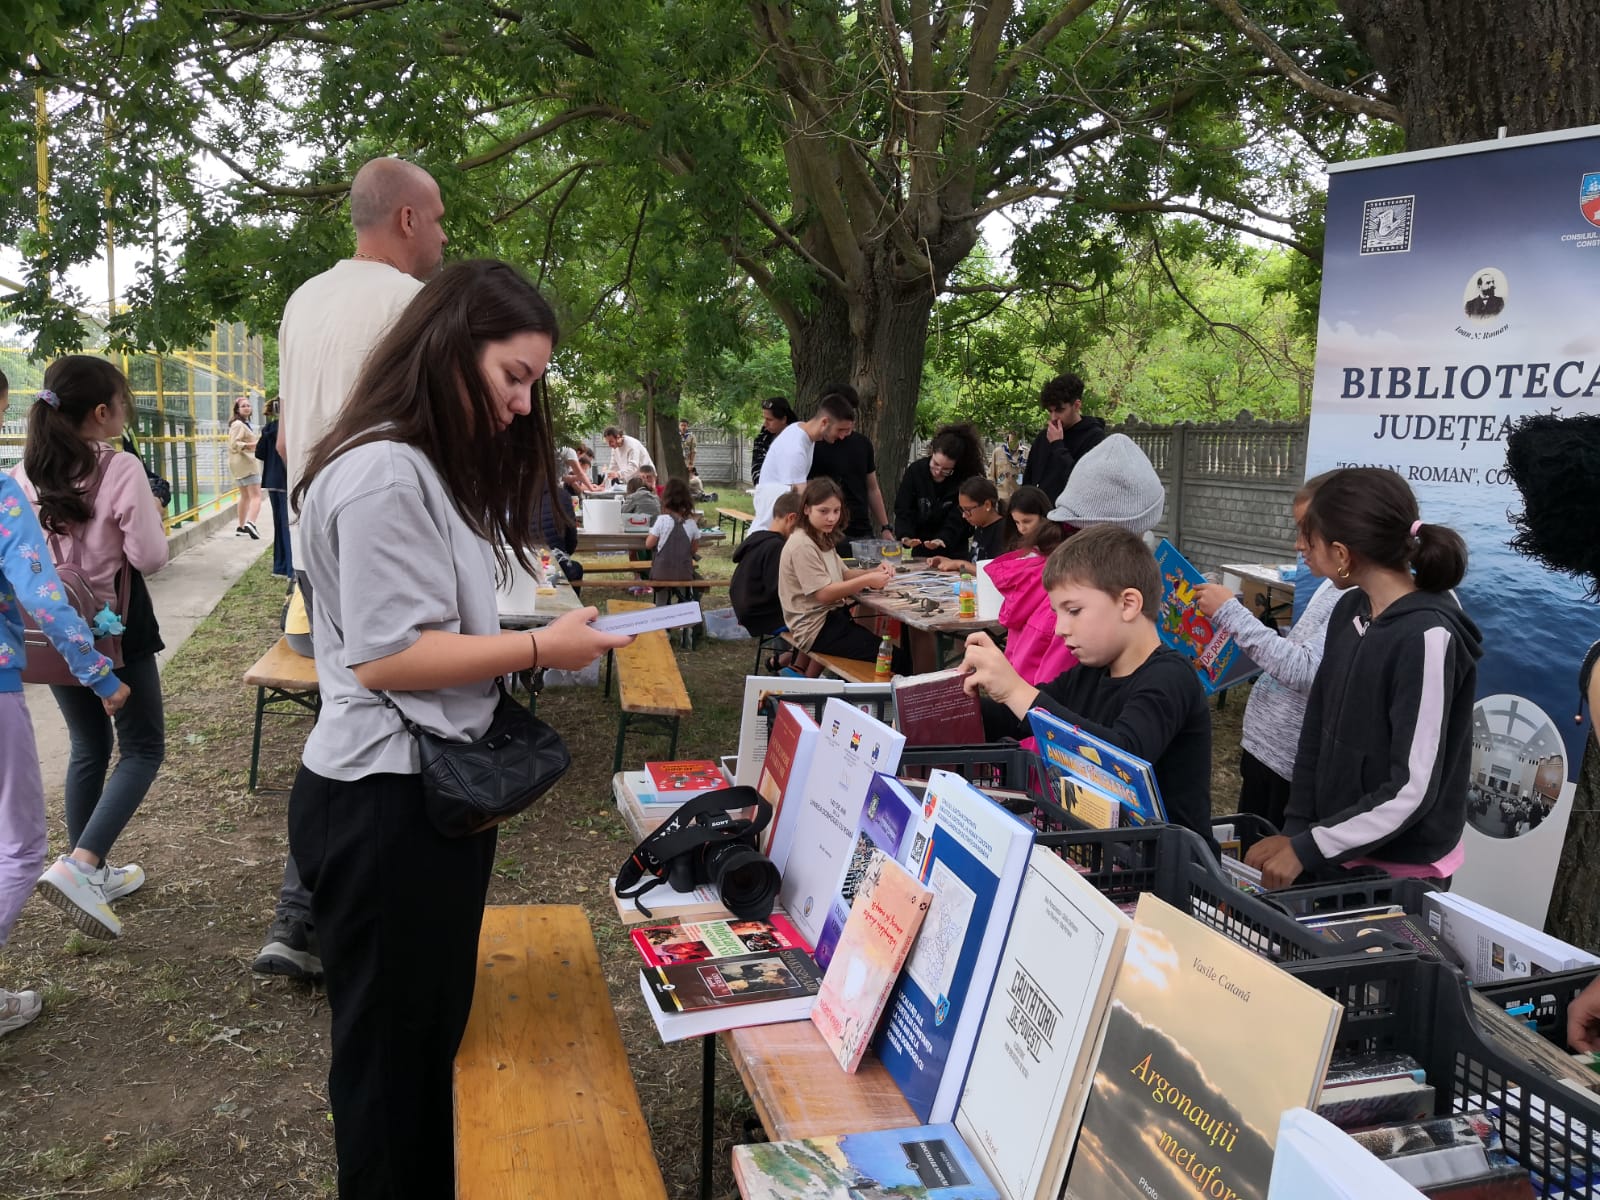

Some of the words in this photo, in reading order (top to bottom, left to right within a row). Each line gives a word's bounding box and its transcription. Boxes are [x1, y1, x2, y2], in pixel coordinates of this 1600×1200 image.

[1561, 231, 1598, 242] CONSILIUL
[1483, 324, 1508, 339] Roman
[1201, 652, 1214, 665] De
[1192, 957, 1218, 982] Vasile
[1217, 974, 1252, 1002] Catană
[1011, 969, 1057, 1042] CĂUTĂTORII
[1131, 1053, 1240, 1152] Argonauții
[1157, 1130, 1245, 1200] metafor
[1138, 1176, 1158, 1200] Photo
